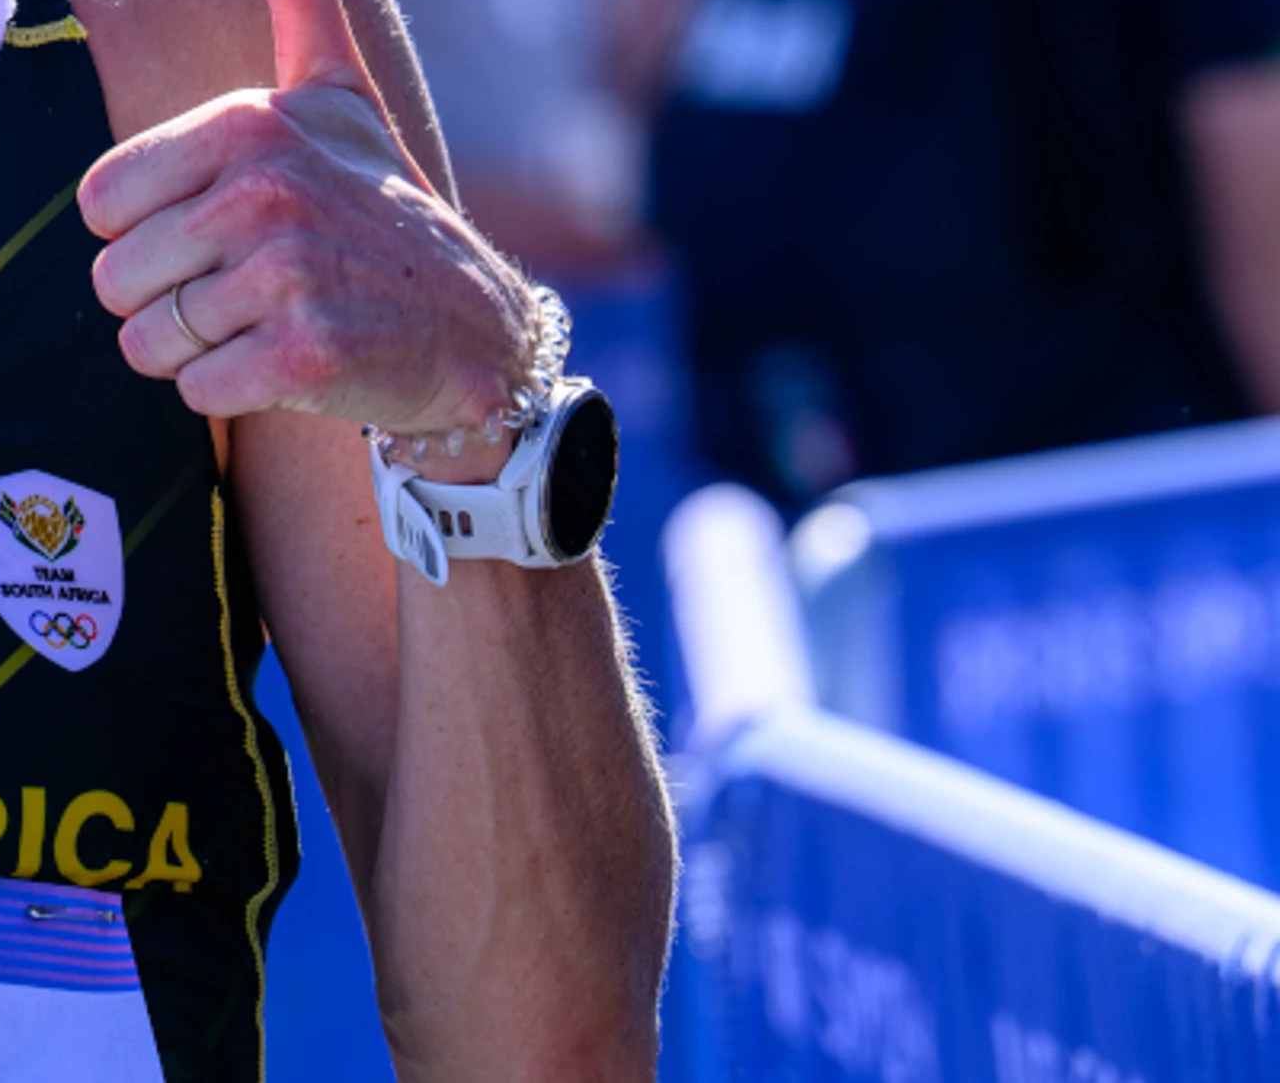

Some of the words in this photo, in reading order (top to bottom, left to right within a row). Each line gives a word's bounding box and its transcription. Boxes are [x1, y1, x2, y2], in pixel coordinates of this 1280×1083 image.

[32, 565, 76, 583] TEAM
[0, 583, 54, 599] SOUTH
[58, 588, 112, 605] AFRICA
